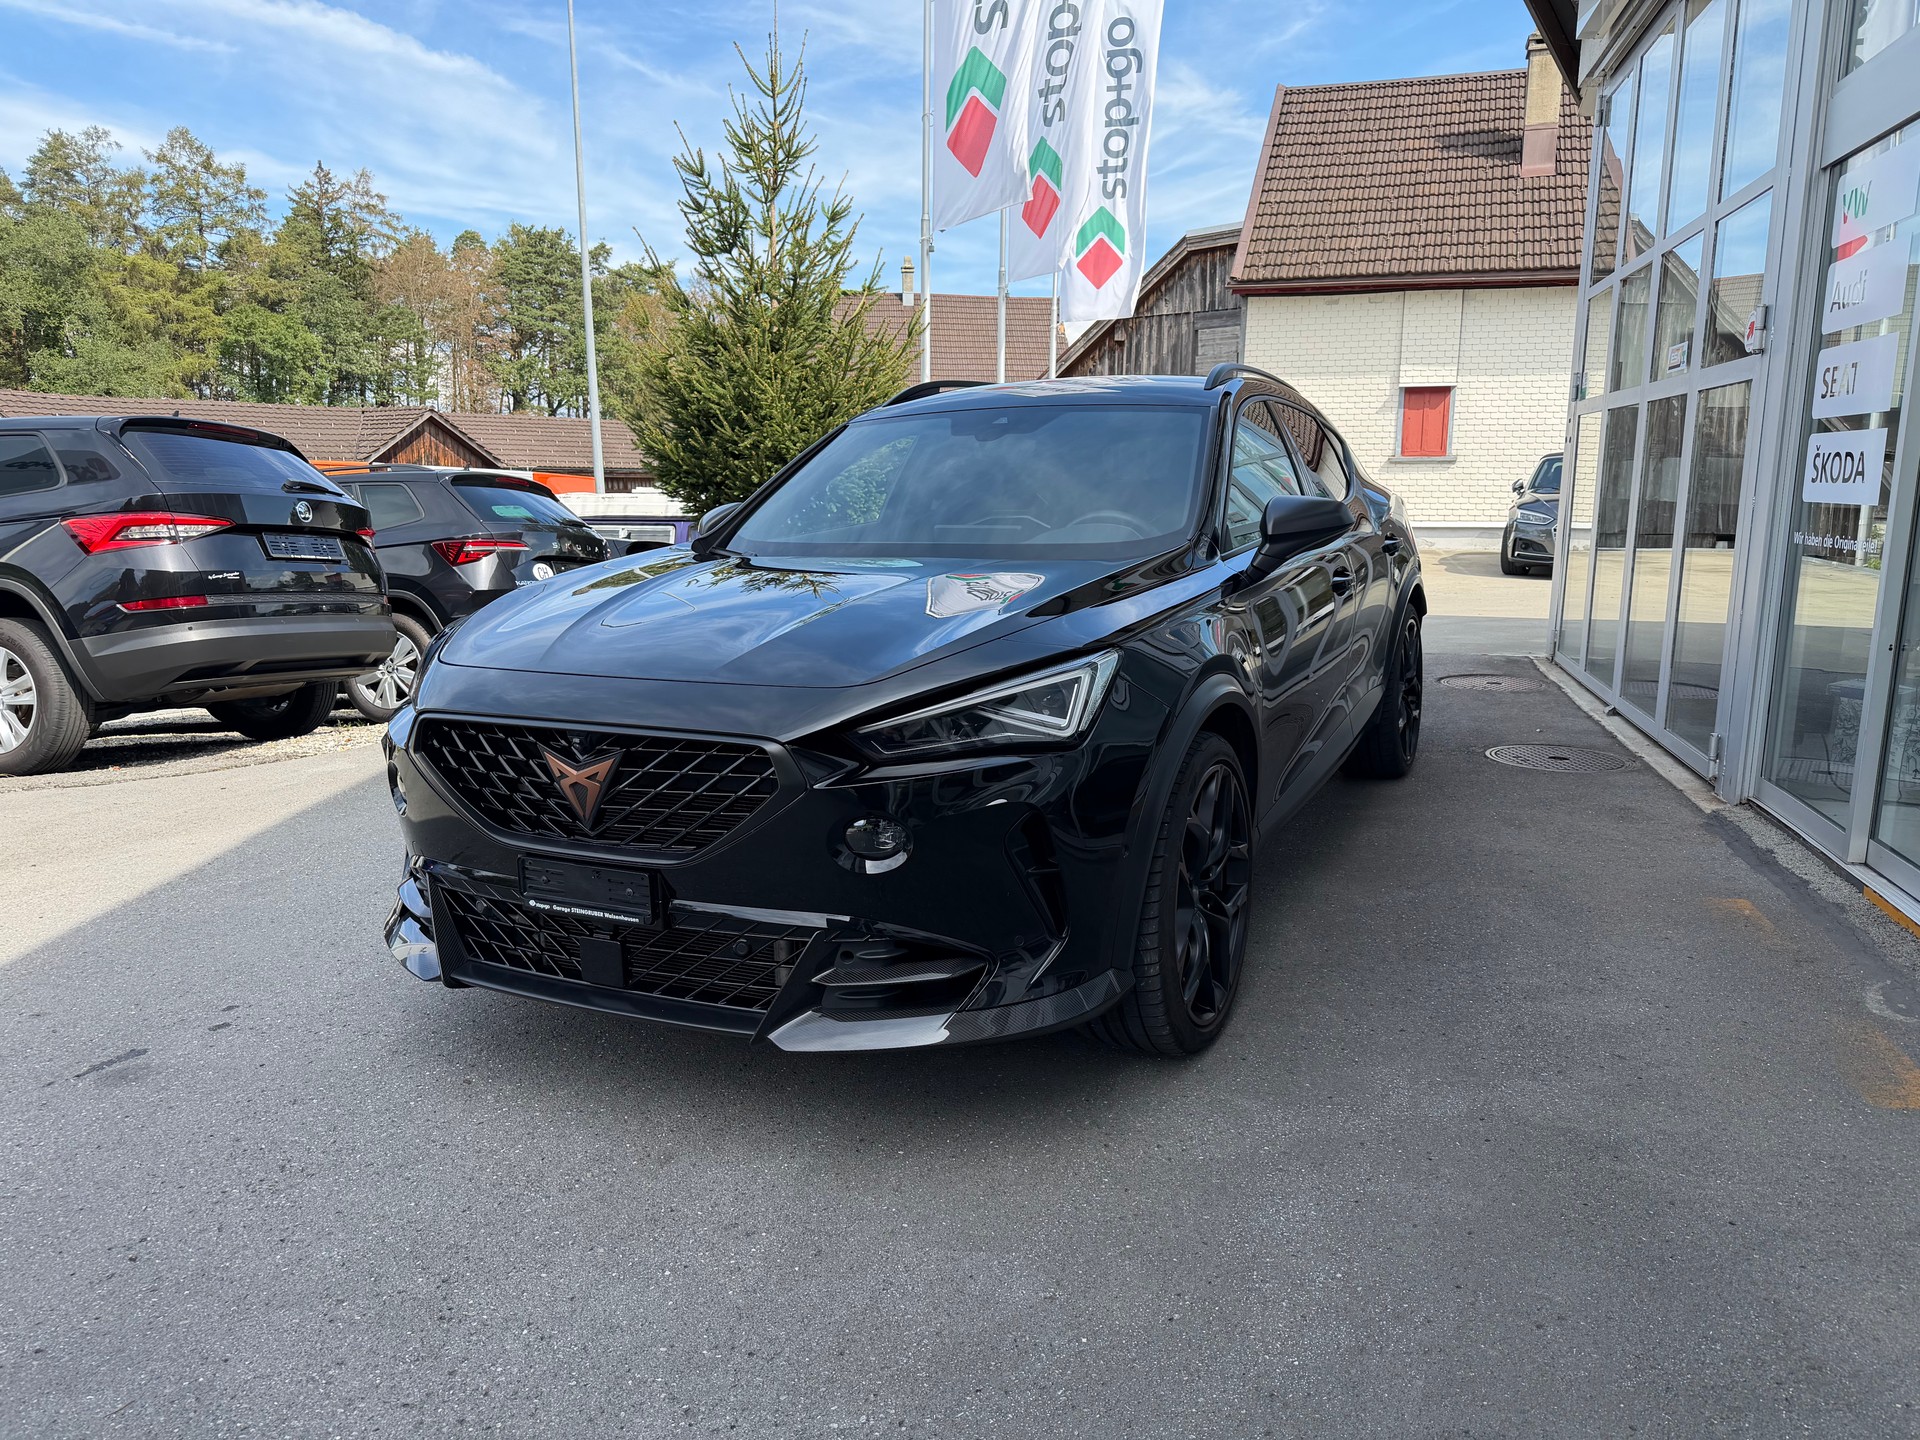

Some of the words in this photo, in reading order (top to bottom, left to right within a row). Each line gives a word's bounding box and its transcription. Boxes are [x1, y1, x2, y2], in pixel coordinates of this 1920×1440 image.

[974, 0, 1009, 35] s
[1038, 0, 1083, 128] stop
[1096, 16, 1143, 200] stop+go
[1843, 180, 1872, 225] VW
[1830, 269, 1868, 312] Audi
[1821, 361, 1861, 399] SEAT
[1811, 444, 1865, 484] ŠKODA
[1794, 532, 1804, 545] Wir
[1804, 532, 1823, 547] haben
[1823, 533, 1833, 549] die
[1834, 535, 1878, 554] Originaeile!
[552, 904, 571, 913] Garage
